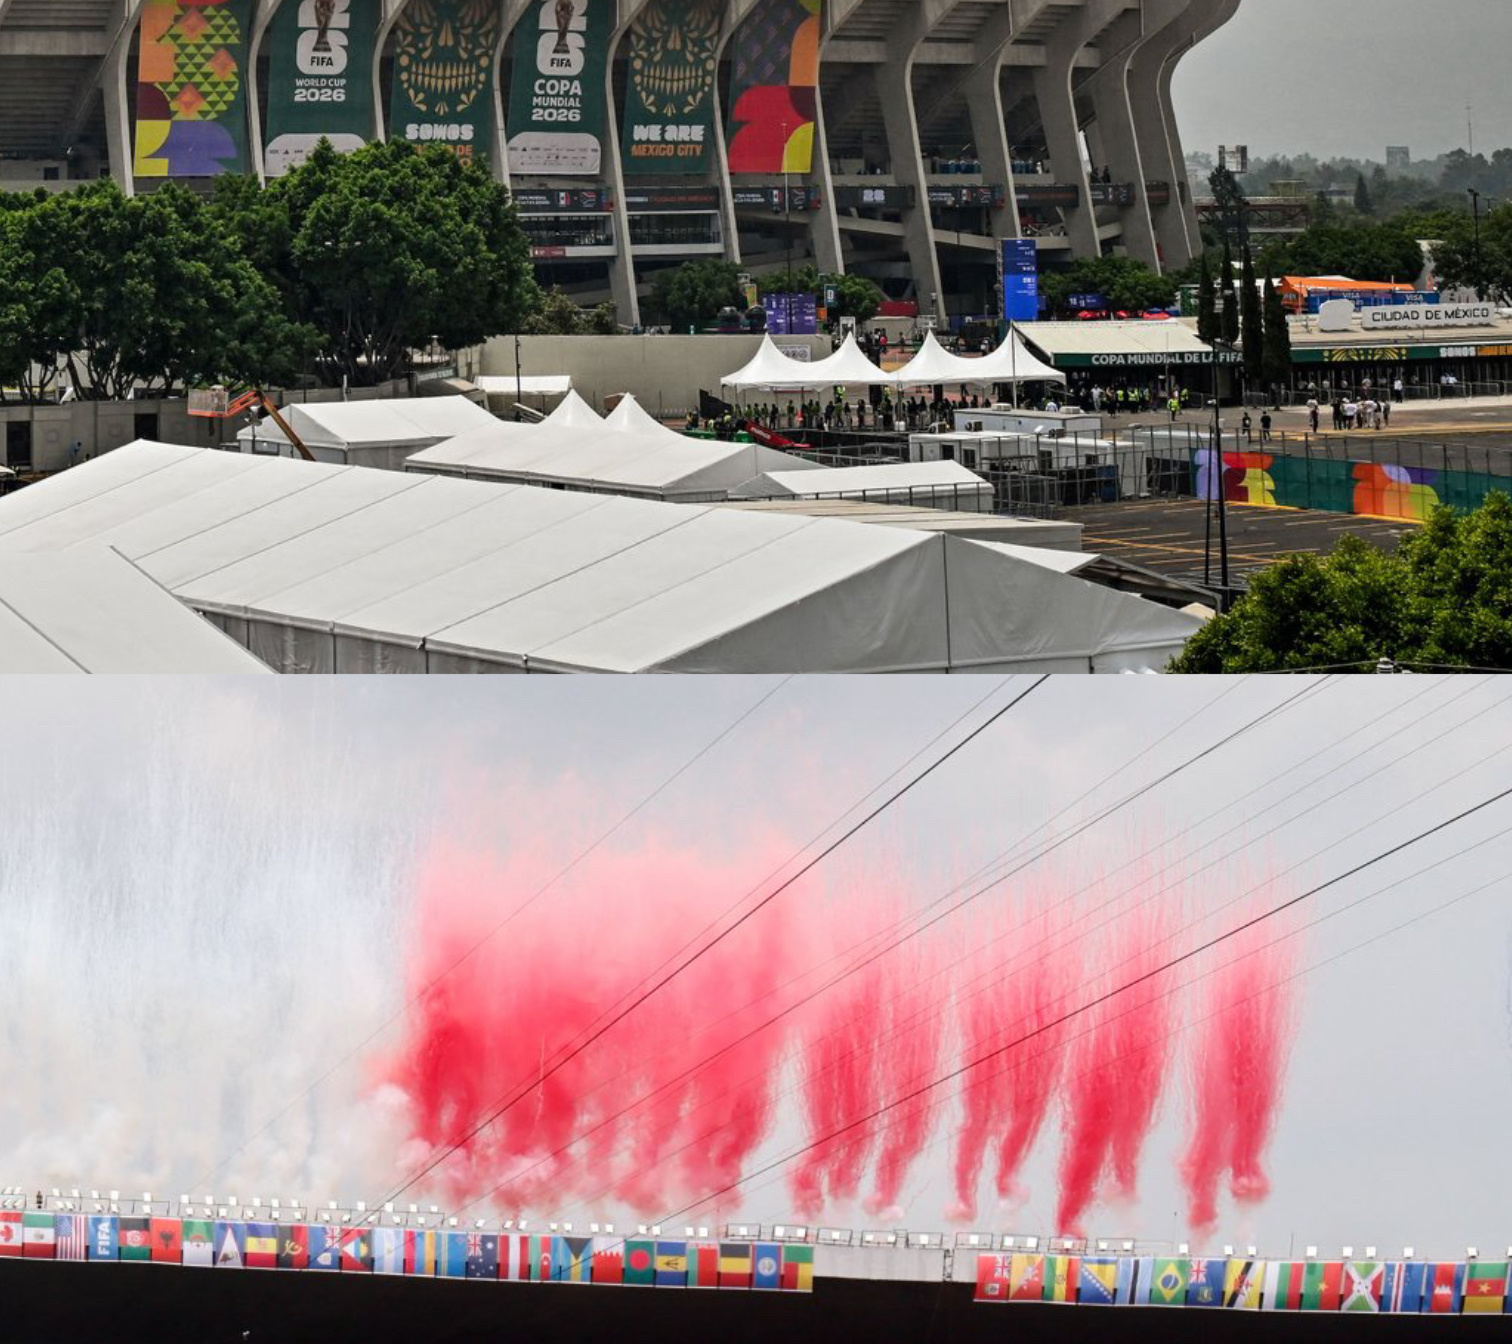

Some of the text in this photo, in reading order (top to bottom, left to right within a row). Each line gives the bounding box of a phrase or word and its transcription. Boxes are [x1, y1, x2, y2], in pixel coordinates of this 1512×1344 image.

[310, 56, 334, 66] FIFA
[550, 57, 572, 68] FIFA
[296, 78, 346, 87] WORLD CUP
[534, 79, 582, 96] COPA
[294, 88, 346, 102] 2026
[532, 96, 581, 107] MUNDIAL
[531, 108, 581, 122] 2026
[405, 123, 474, 140] SOMOS
[633, 124, 662, 141] WE
[631, 144, 703, 156] MEXICO CITY
[1405, 293, 1424, 302] VISA
[1372, 306, 1489, 323] CIUDAD DE MÉXICO
[1091, 351, 1245, 366] COPA MUNDIAL DE LA FIFA
[96, 1221, 110, 1256] FIFA
